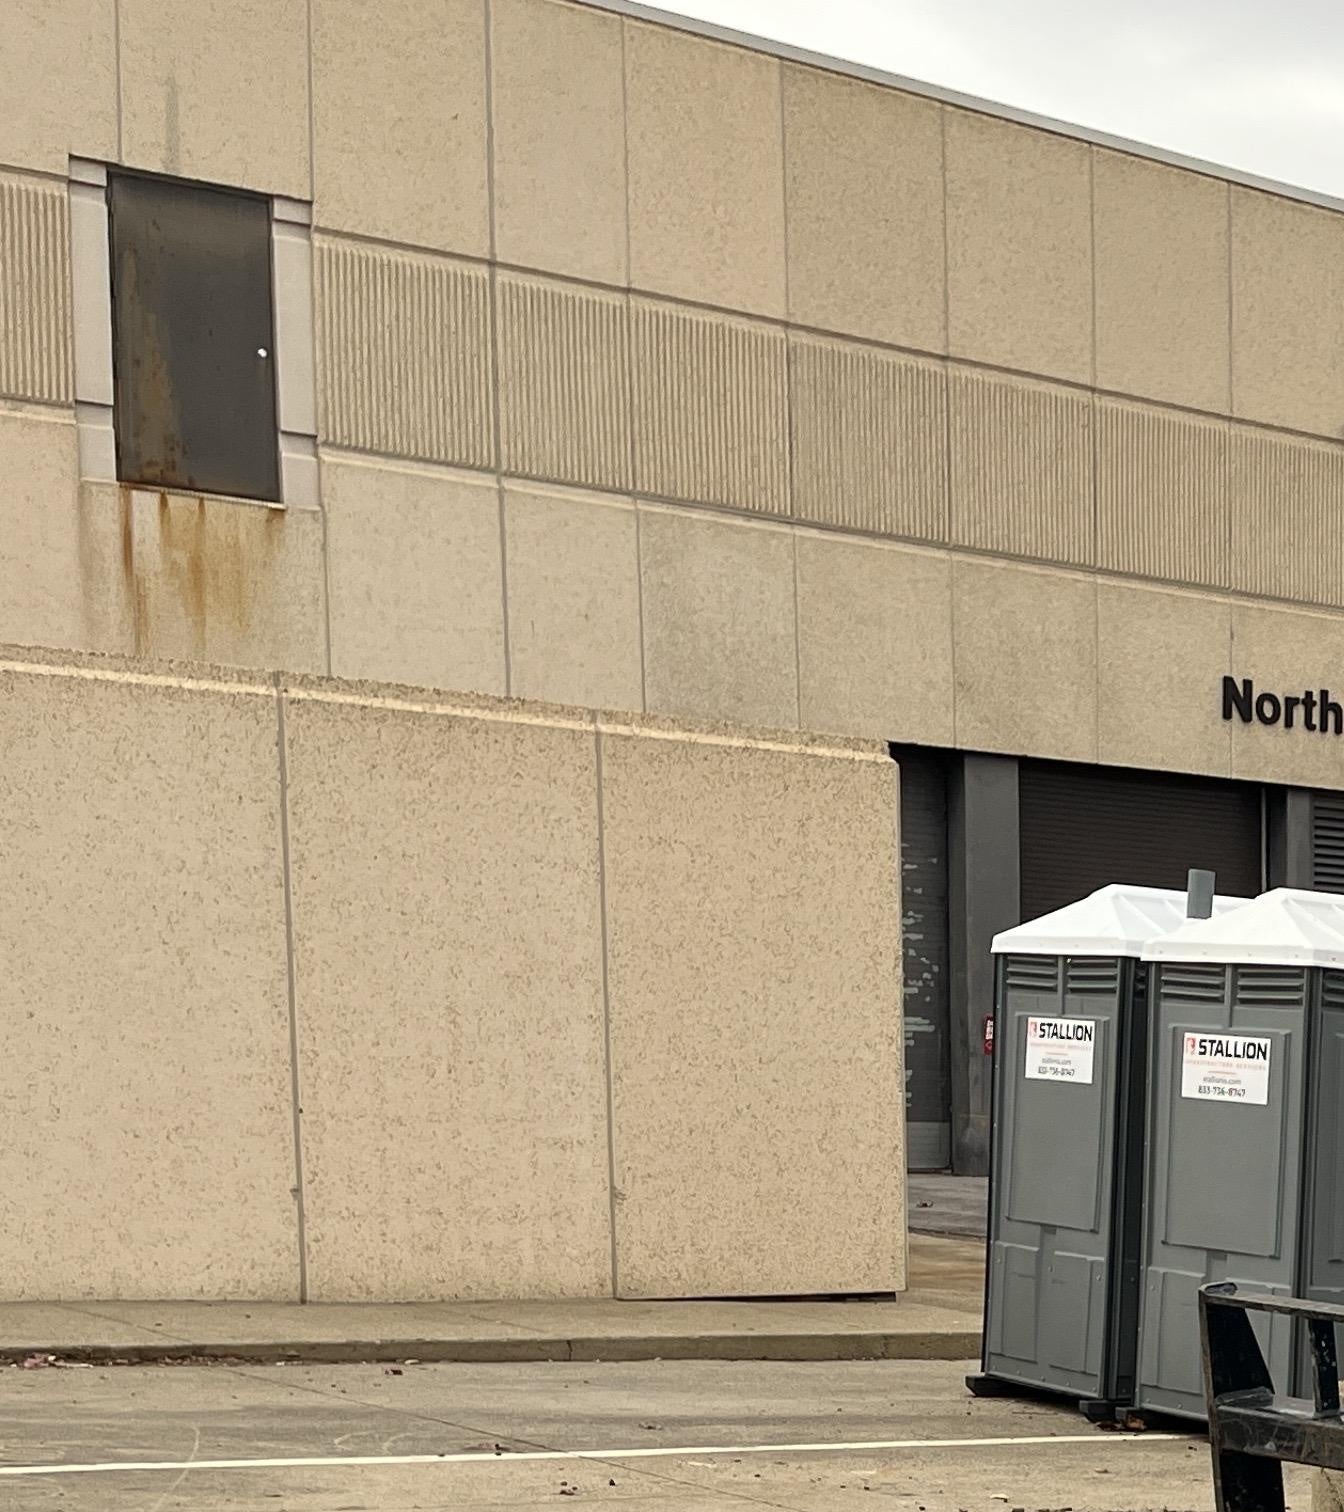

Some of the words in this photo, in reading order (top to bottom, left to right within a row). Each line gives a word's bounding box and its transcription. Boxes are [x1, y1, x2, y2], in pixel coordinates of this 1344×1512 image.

[1221, 675, 1344, 735] North
[1039, 1022, 1093, 1042] STALLION
[1198, 1039, 1268, 1061] STALLION
